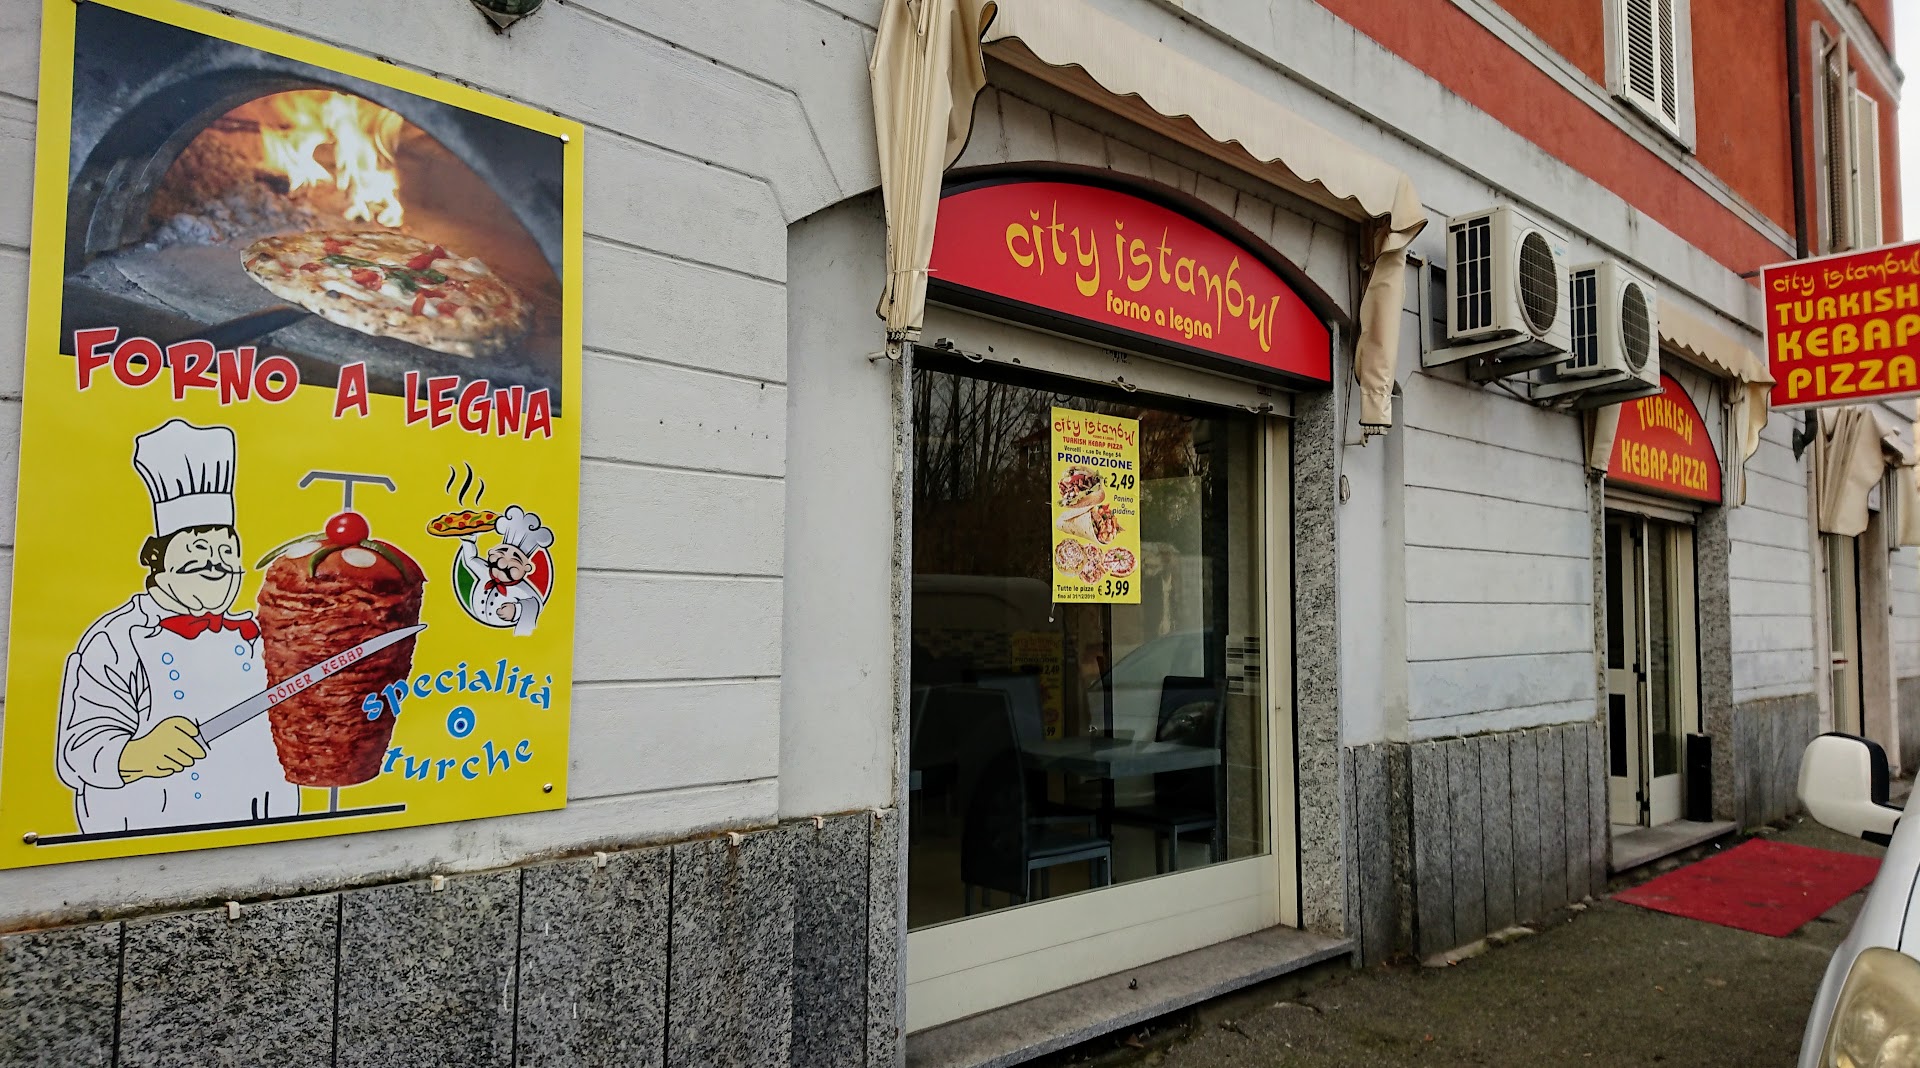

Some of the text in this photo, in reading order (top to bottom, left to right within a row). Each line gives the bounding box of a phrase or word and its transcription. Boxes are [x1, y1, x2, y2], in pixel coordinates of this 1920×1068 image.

[1005, 199, 1281, 353] city istanbul
[1773, 271, 1815, 297] city
[1106, 289, 1213, 339] forno a legna
[1775, 282, 1919, 326] TURKISH
[1777, 313, 1920, 363] KEBAP
[74, 327, 553, 440] FORNO A LEGNA
[1787, 354, 1918, 399] PIZZA
[1054, 415, 1136, 446] city istanbul
[1636, 396, 1693, 446] TURKISH
[1057, 452, 1133, 470] PROMOZIONE
[1063, 436, 1087, 445] TURKISH
[1107, 442, 1123, 450] PIZZA
[1110, 472, 1135, 490] 2,49
[1621, 438, 1708, 492] KEBAP-PIZZA
[1112, 507, 1135, 516] piadina
[1113, 494, 1134, 503] Panino
[1056, 584, 1072, 592] Tutte
[1073, 584, 1079, 592] le
[1097, 579, 1130, 598] € 3,99
[267, 646, 364, 704] DÖNER KEBAP
[362, 658, 552, 721] specialità
[383, 739, 533, 782] turche
